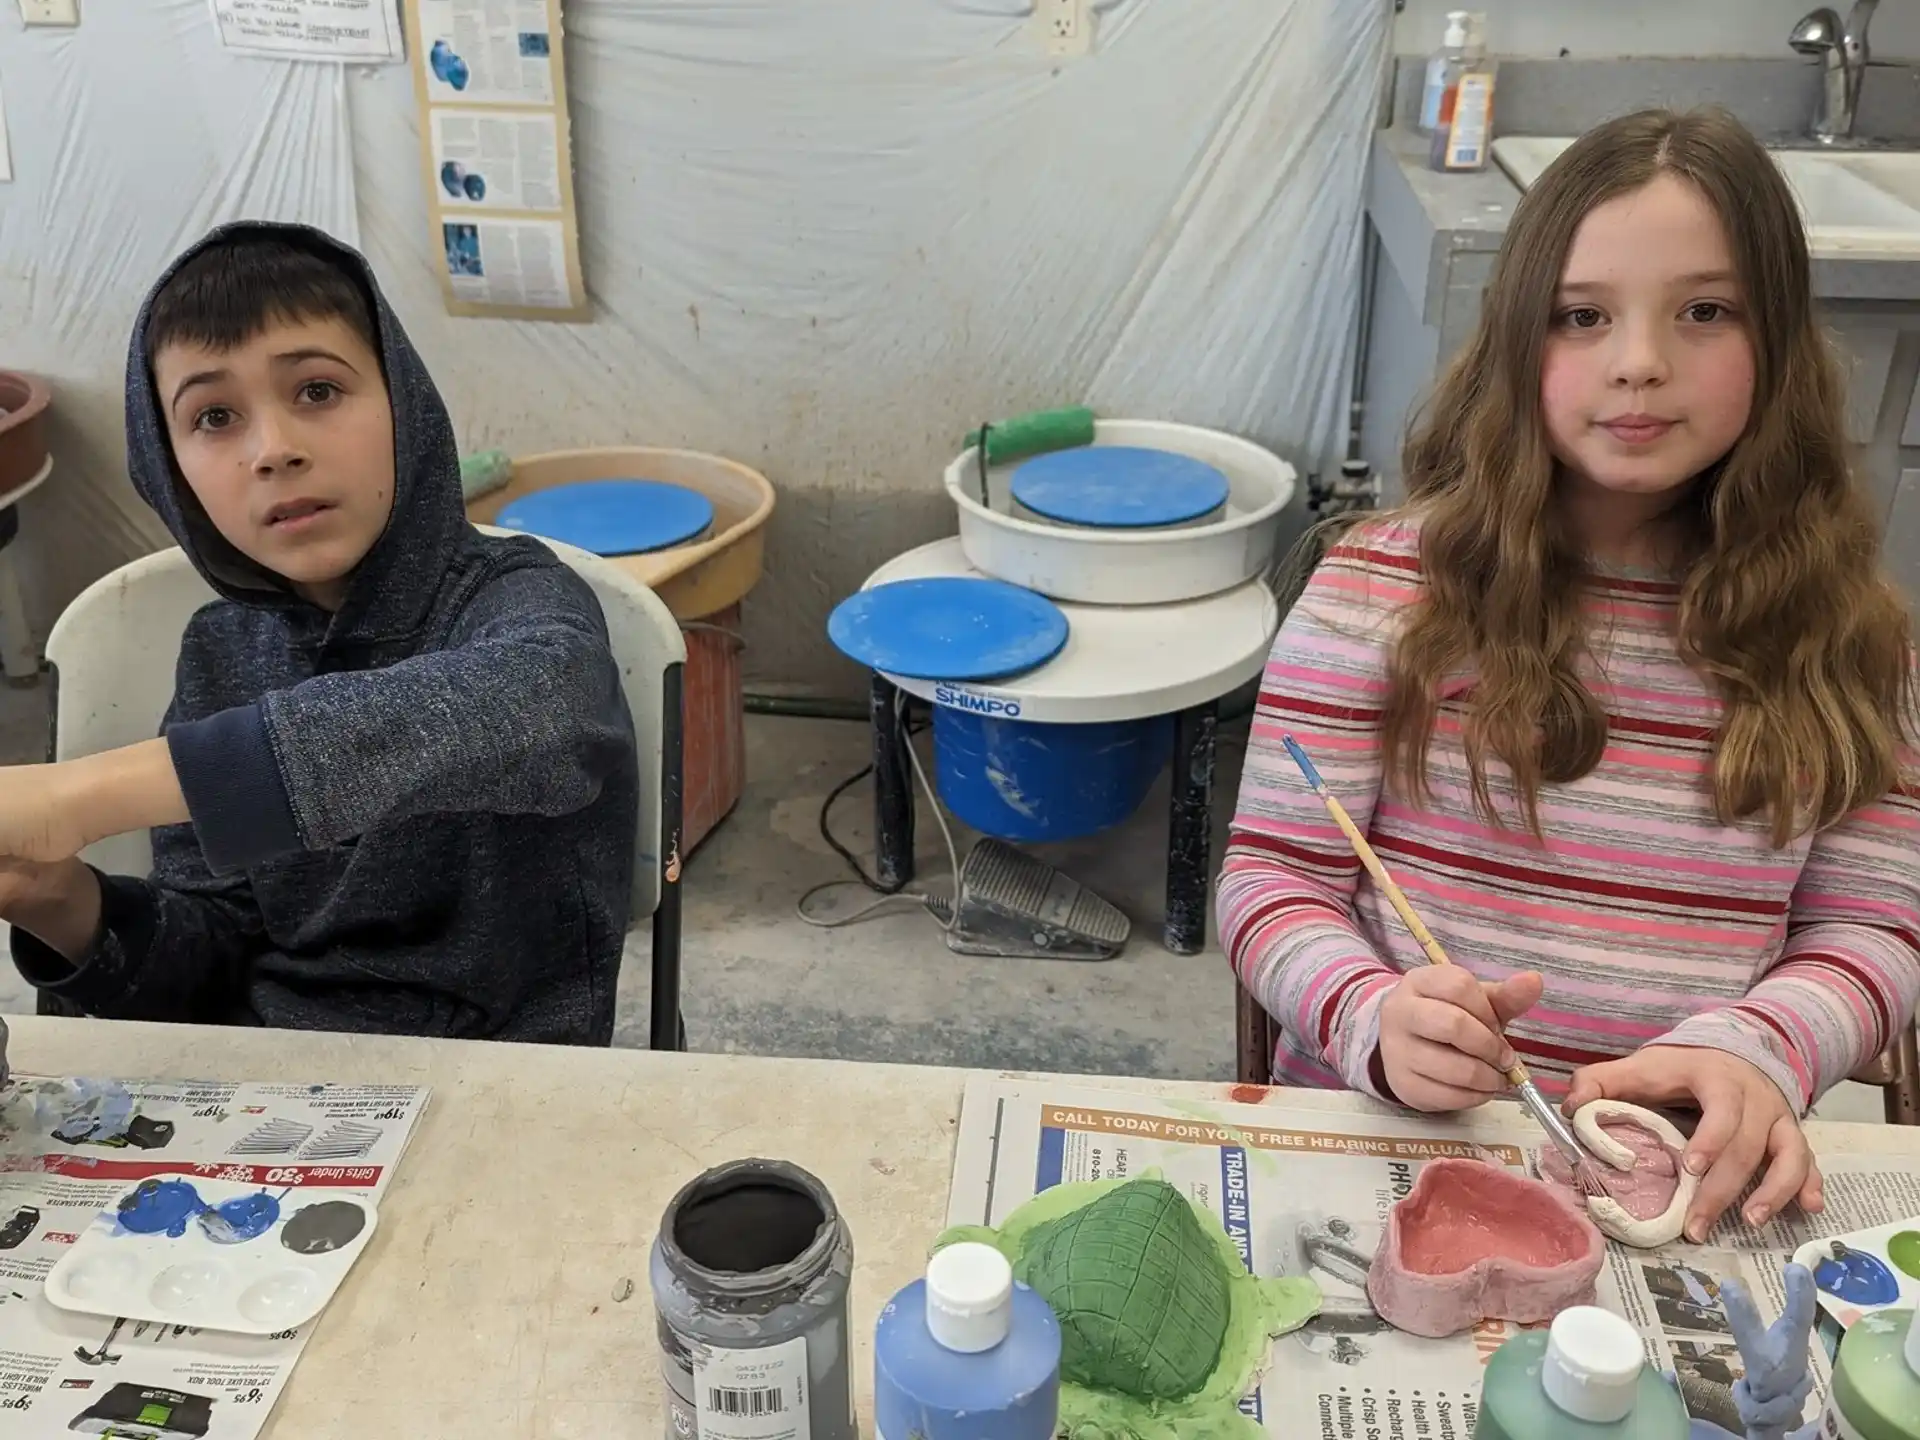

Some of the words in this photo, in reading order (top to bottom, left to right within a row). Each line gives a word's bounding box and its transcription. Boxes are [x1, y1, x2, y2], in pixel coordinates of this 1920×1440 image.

[935, 688, 1020, 717] SHIMPO
[1052, 1111, 1097, 1126] CALL
[1102, 1116, 1161, 1133] TODAY
[1165, 1124, 1201, 1138] FOR
[1260, 1132, 1306, 1147] FREE
[1310, 1137, 1390, 1153] HEARING
[1395, 1142, 1512, 1160] EVALUATIN!
[307, 1167, 346, 1180] Under
[347, 1166, 376, 1180] Gifts
[1091, 1148, 1102, 1182] 810-20
[264, 1167, 305, 1185] $30
[1388, 1162, 1413, 1201] PHO
[1225, 1151, 1246, 1221] TRADE-IN
[1375, 1189, 1391, 1208] life
[1, 1381, 43, 1393] WIRELESS
[2, 1372, 26, 1383] LIGHT
[26, 1375, 49, 1385] BULB
[186, 1376, 205, 1385] BOX
[206, 1377, 226, 1385] TOOL
[225, 1377, 258, 1386] DELUXE
[232, 1388, 263, 1404] $695
[1318, 1394, 1337, 1440] Connecti
[1337, 1395, 1356, 1439] Multiple
[1361, 1397, 1379, 1425] Crisp
[1386, 1398, 1405, 1440] Recharg
[1411, 1400, 1431, 1434] Health
[1436, 1401, 1456, 1440] Sweatp
[1365, 1427, 1381, 1440] So
